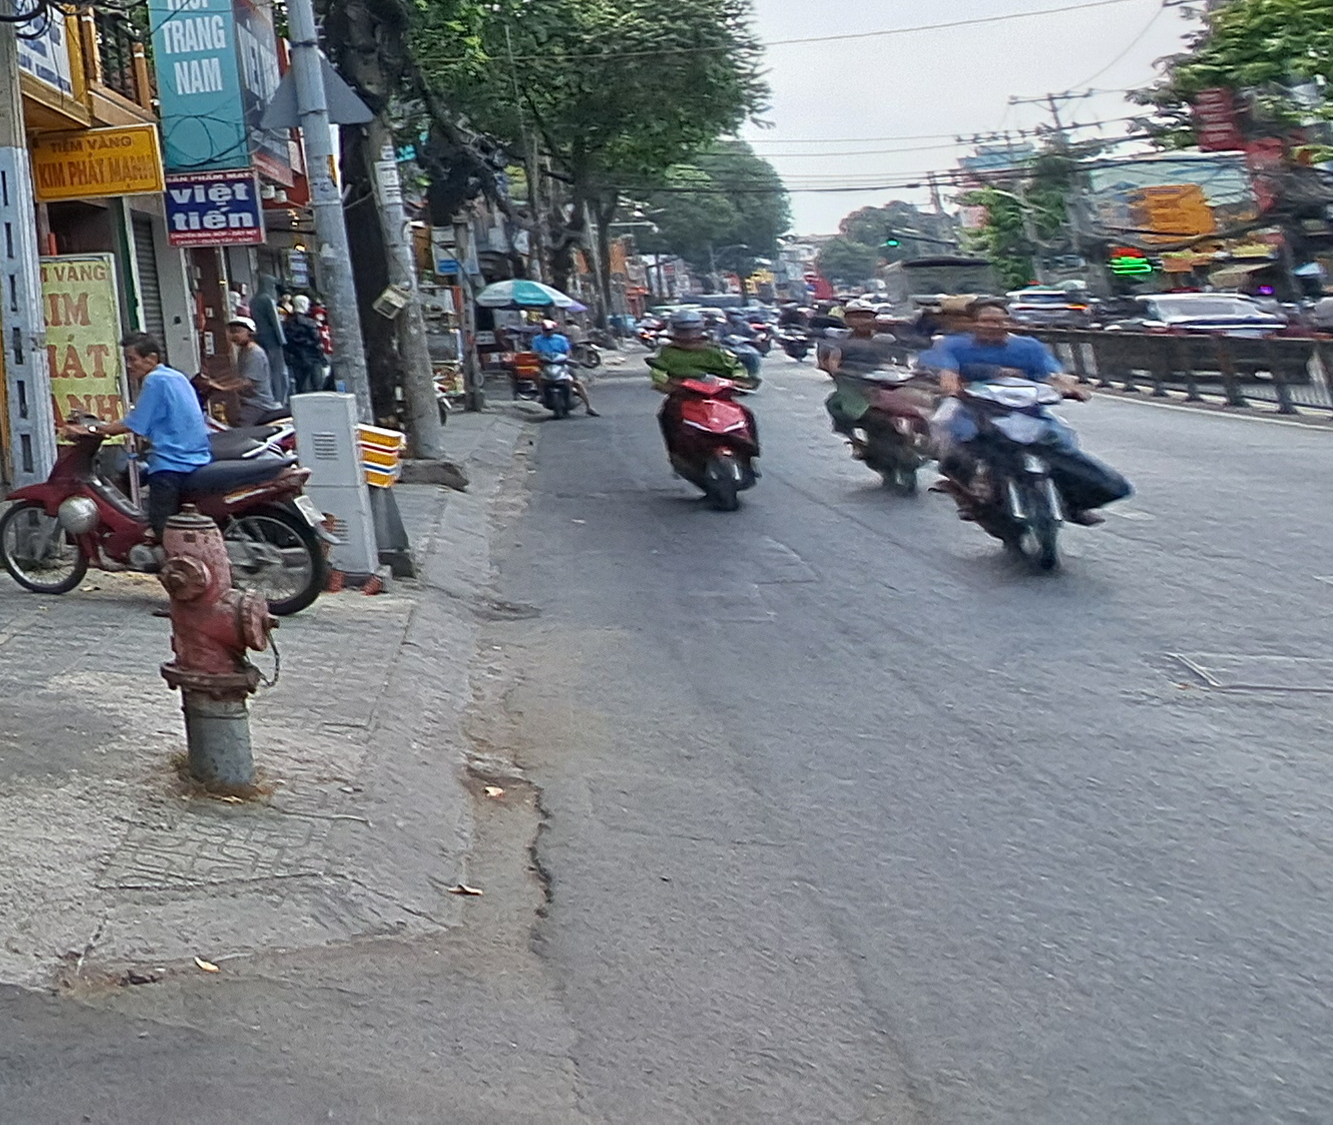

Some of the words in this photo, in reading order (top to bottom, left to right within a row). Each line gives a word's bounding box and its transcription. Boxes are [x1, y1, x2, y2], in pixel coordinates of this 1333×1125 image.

[161, 14, 226, 55] TRANG
[173, 57, 224, 95] NAM
[51, 137, 83, 159] TIỆM
[88, 133, 133, 152] VÀNG
[37, 160, 66, 190] KIM
[67, 151, 106, 188] PHÁT
[169, 182, 250, 206] việt
[172, 206, 255, 231] tiến
[53, 258, 107, 282] VÀNG
[43, 293, 91, 327] IM
